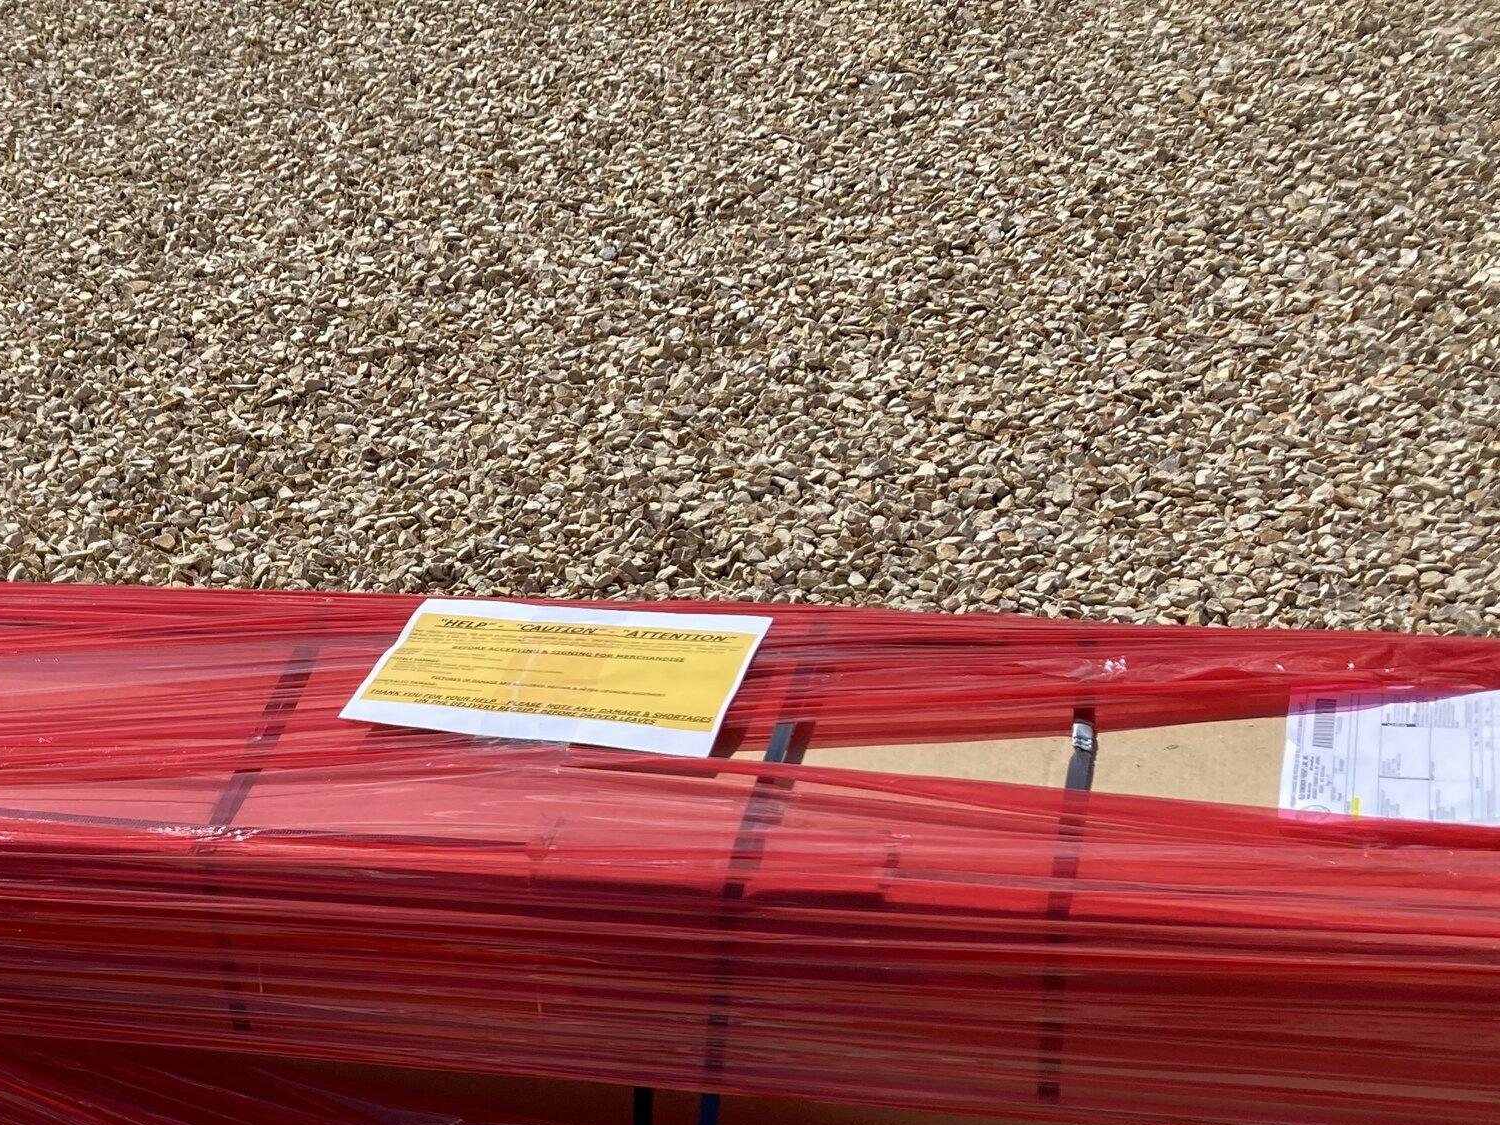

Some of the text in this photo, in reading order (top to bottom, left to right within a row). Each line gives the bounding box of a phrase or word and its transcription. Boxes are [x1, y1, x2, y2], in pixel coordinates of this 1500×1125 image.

[551, 650, 593, 658] SIGNING
[615, 653, 686, 663] MERCHANDISE
[370, 688, 401, 696] THANK
[402, 690, 420, 698] YOU
[547, 703, 574, 711] NOTE
[575, 705, 595, 713] ANY
[600, 708, 643, 717] DAMAGE
[653, 712, 713, 723] SHORTAGES
[450, 701, 497, 711] DELIVERY
[499, 706, 541, 714] RECEIPT
[542, 709, 577, 717] BEFORE
[580, 713, 618, 721] DRIVER
[619, 716, 657, 725] LEAVES
